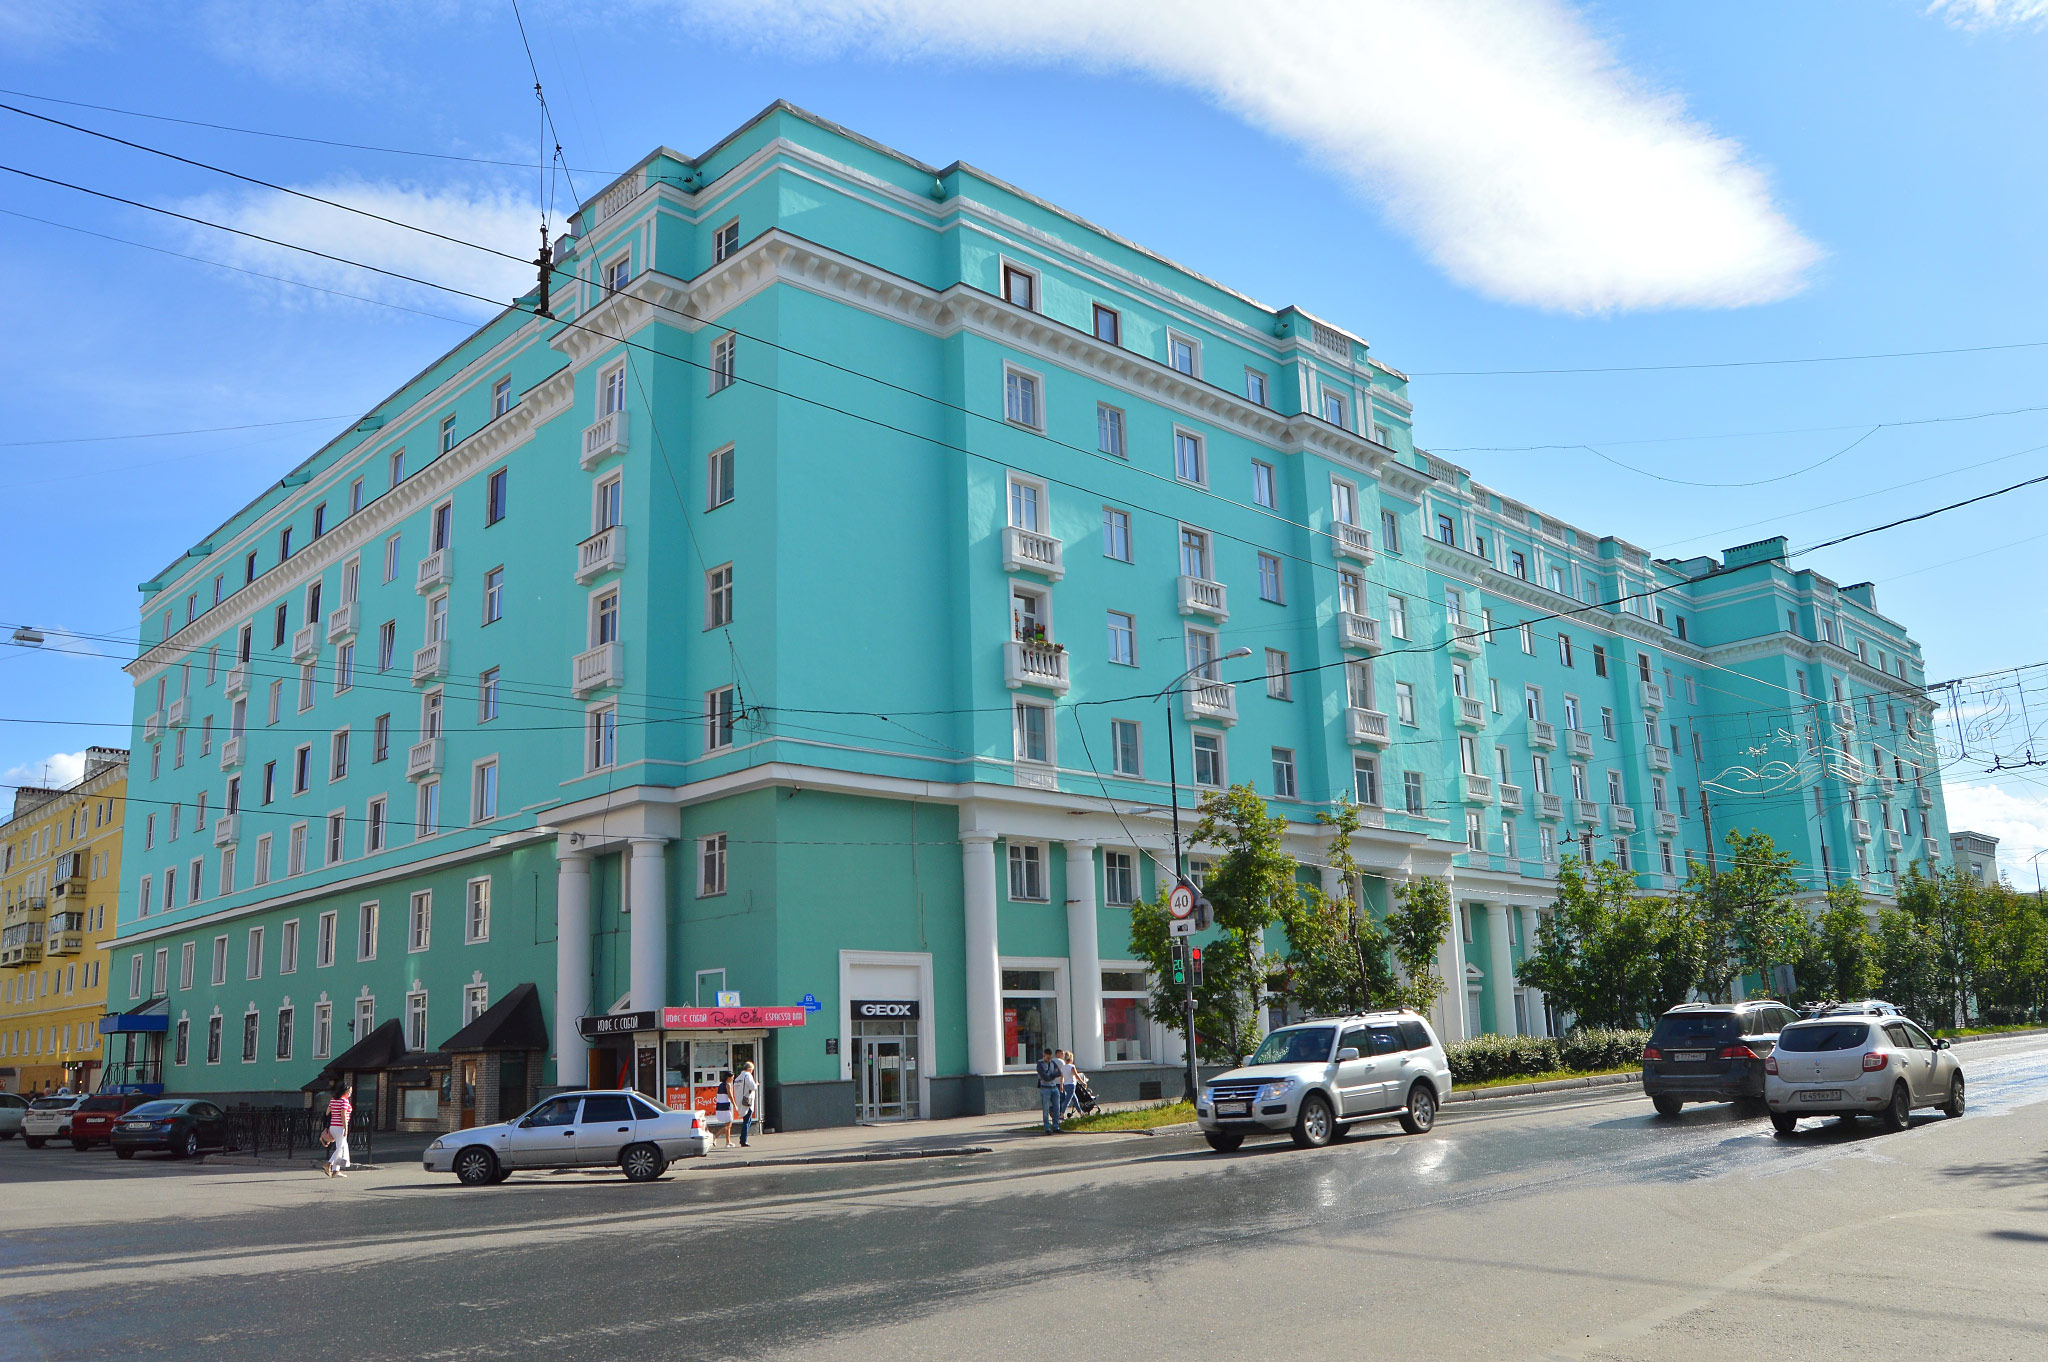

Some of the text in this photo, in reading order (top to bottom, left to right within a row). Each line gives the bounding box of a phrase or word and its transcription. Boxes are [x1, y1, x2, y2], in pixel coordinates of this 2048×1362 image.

[1175, 895, 1189, 908] 40
[860, 1004, 911, 1016] GEOX
[666, 1013, 707, 1023] КОФЕ С СОБОЙ
[710, 1011, 763, 1026] Royal Coffee
[765, 1012, 802, 1021] ESPRESSO BAR
[597, 1015, 639, 1032] КОФЕ С СОБОЙ
[695, 1096, 712, 1107] Royal
